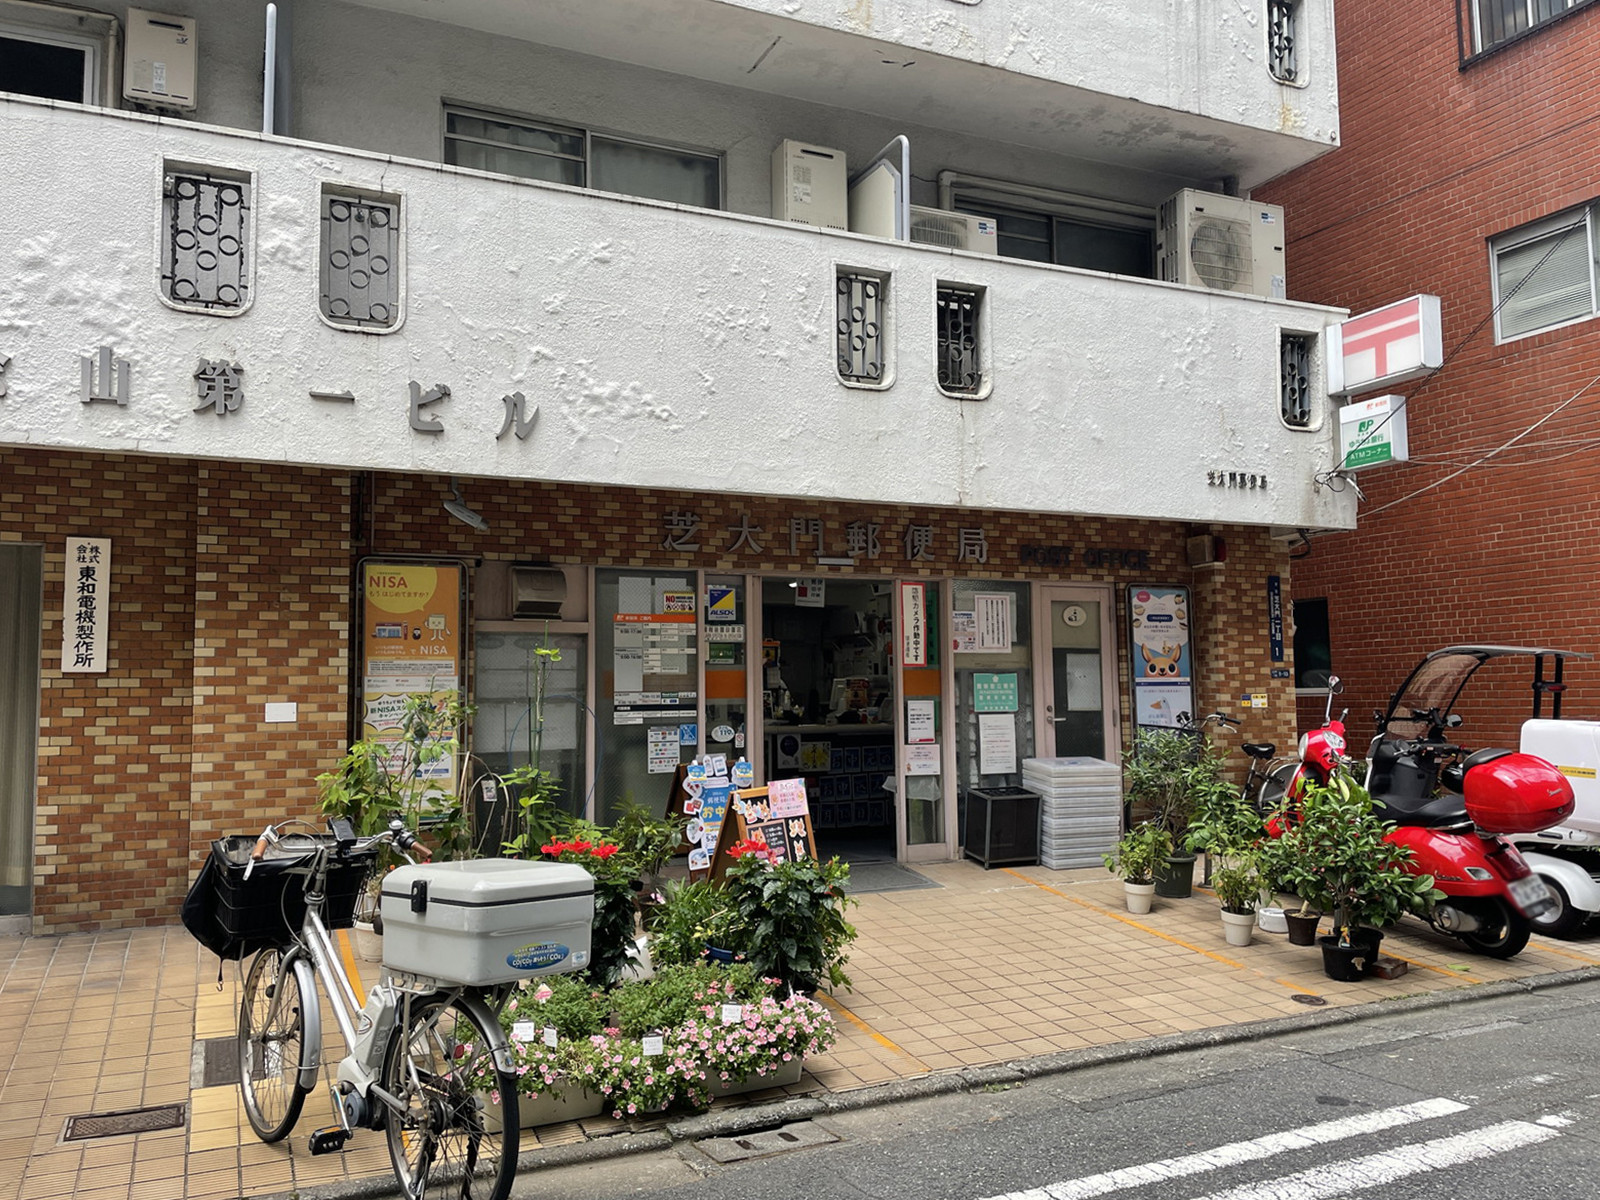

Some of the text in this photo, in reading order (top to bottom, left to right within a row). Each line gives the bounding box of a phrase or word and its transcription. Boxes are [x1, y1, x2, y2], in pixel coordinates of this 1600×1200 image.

[0, 346, 539, 441] 山第一ビル
[663, 510, 1150, 571] 芝大門郵便局 POST OFFICE
[368, 575, 408, 589] NISA
[665, 595, 676, 603] NO
[73, 565, 98, 668] 東和電機製作所
[420, 645, 448, 655] NISA
